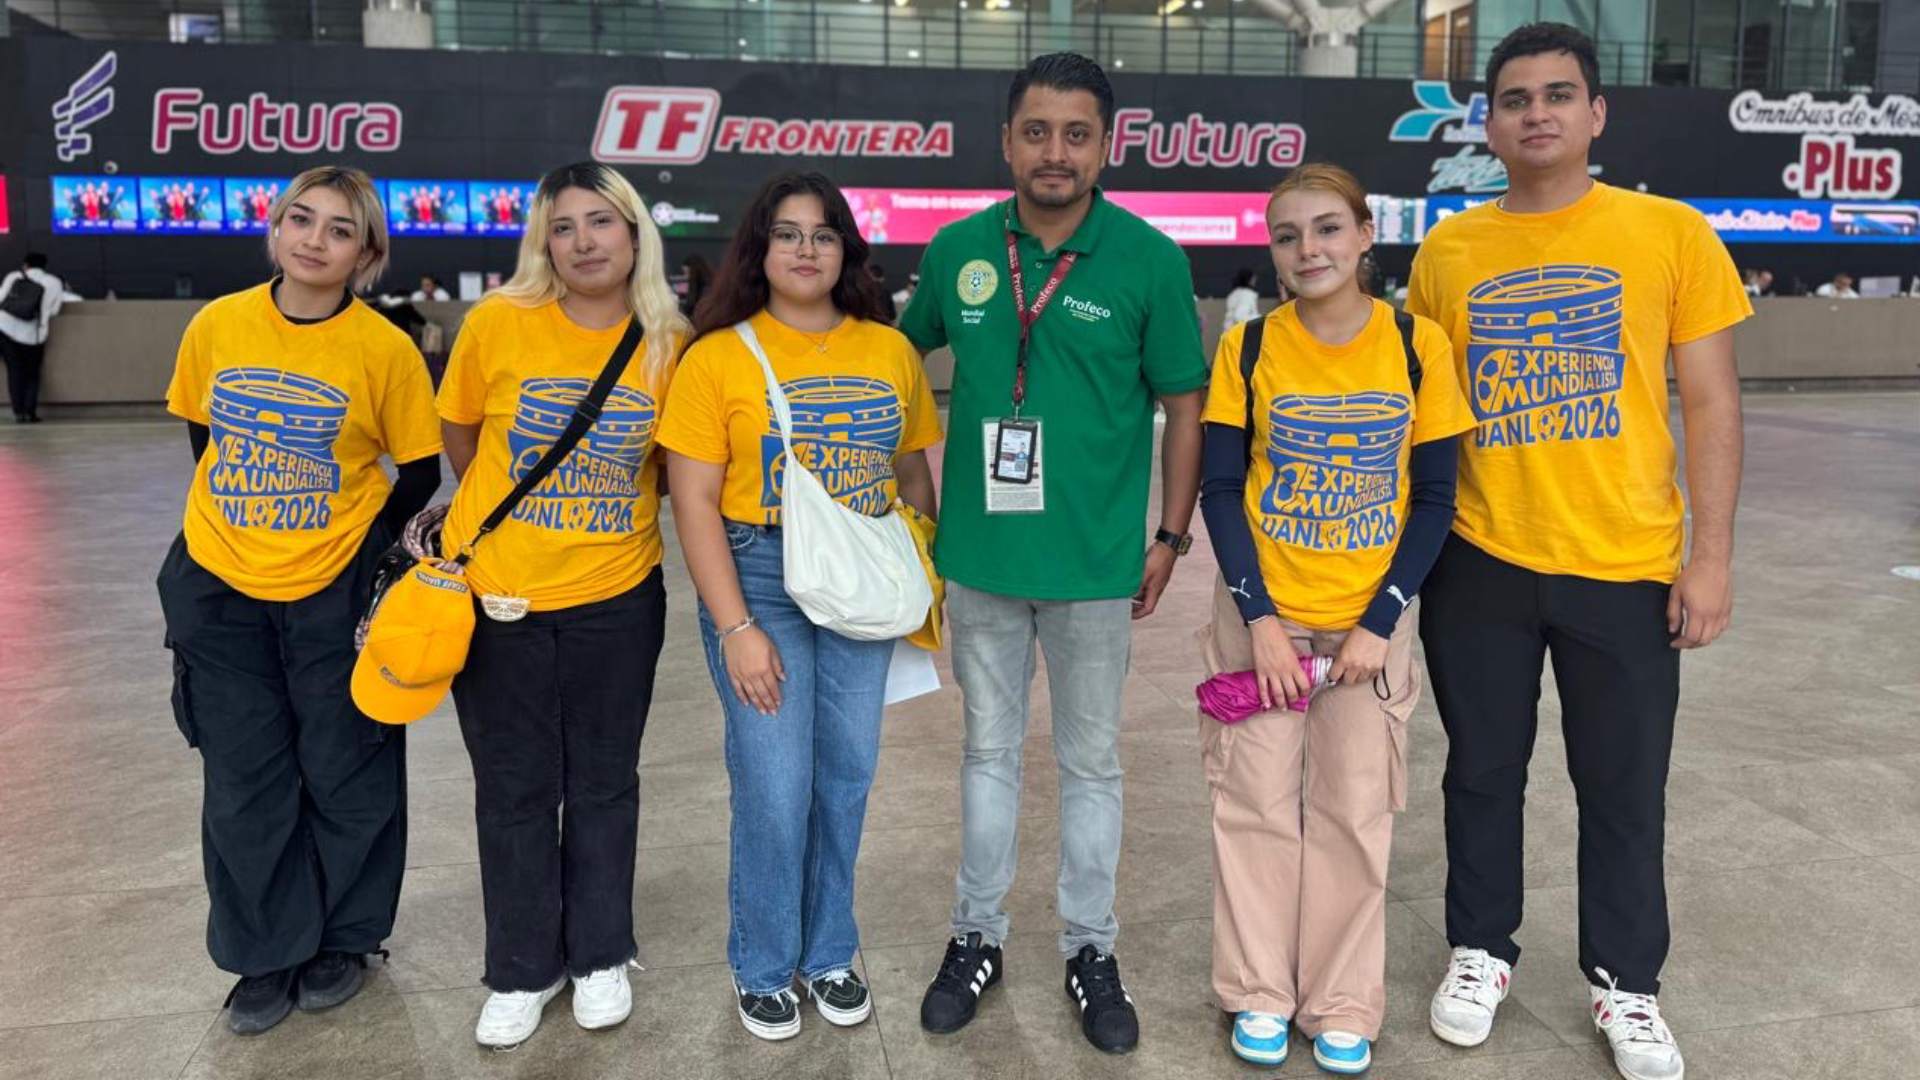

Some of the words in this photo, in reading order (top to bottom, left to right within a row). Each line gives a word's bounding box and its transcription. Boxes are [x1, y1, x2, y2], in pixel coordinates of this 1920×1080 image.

[152, 87, 402, 154] Futura
[614, 99, 706, 152] TF
[714, 116, 955, 158] FRONTERA
[1838, 99, 1866, 127] de
[1109, 108, 1306, 168] Futura
[1803, 139, 1894, 192] Plus
[1031, 278, 1058, 313] Profeco
[1062, 295, 1112, 319] Profeco
[1502, 350, 1616, 378] EXPERIENCIA
[1491, 371, 1618, 413] MUNDIALISTA
[1475, 414, 1536, 448] UANL
[1558, 394, 1621, 440] 2026
[226, 436, 333, 478] EXPERIENCIA
[219, 466, 333, 493] MUNDIALISTA
[270, 494, 332, 530] 2026
[1261, 517, 1324, 550] UANL
[1346, 504, 1397, 551] 2026
